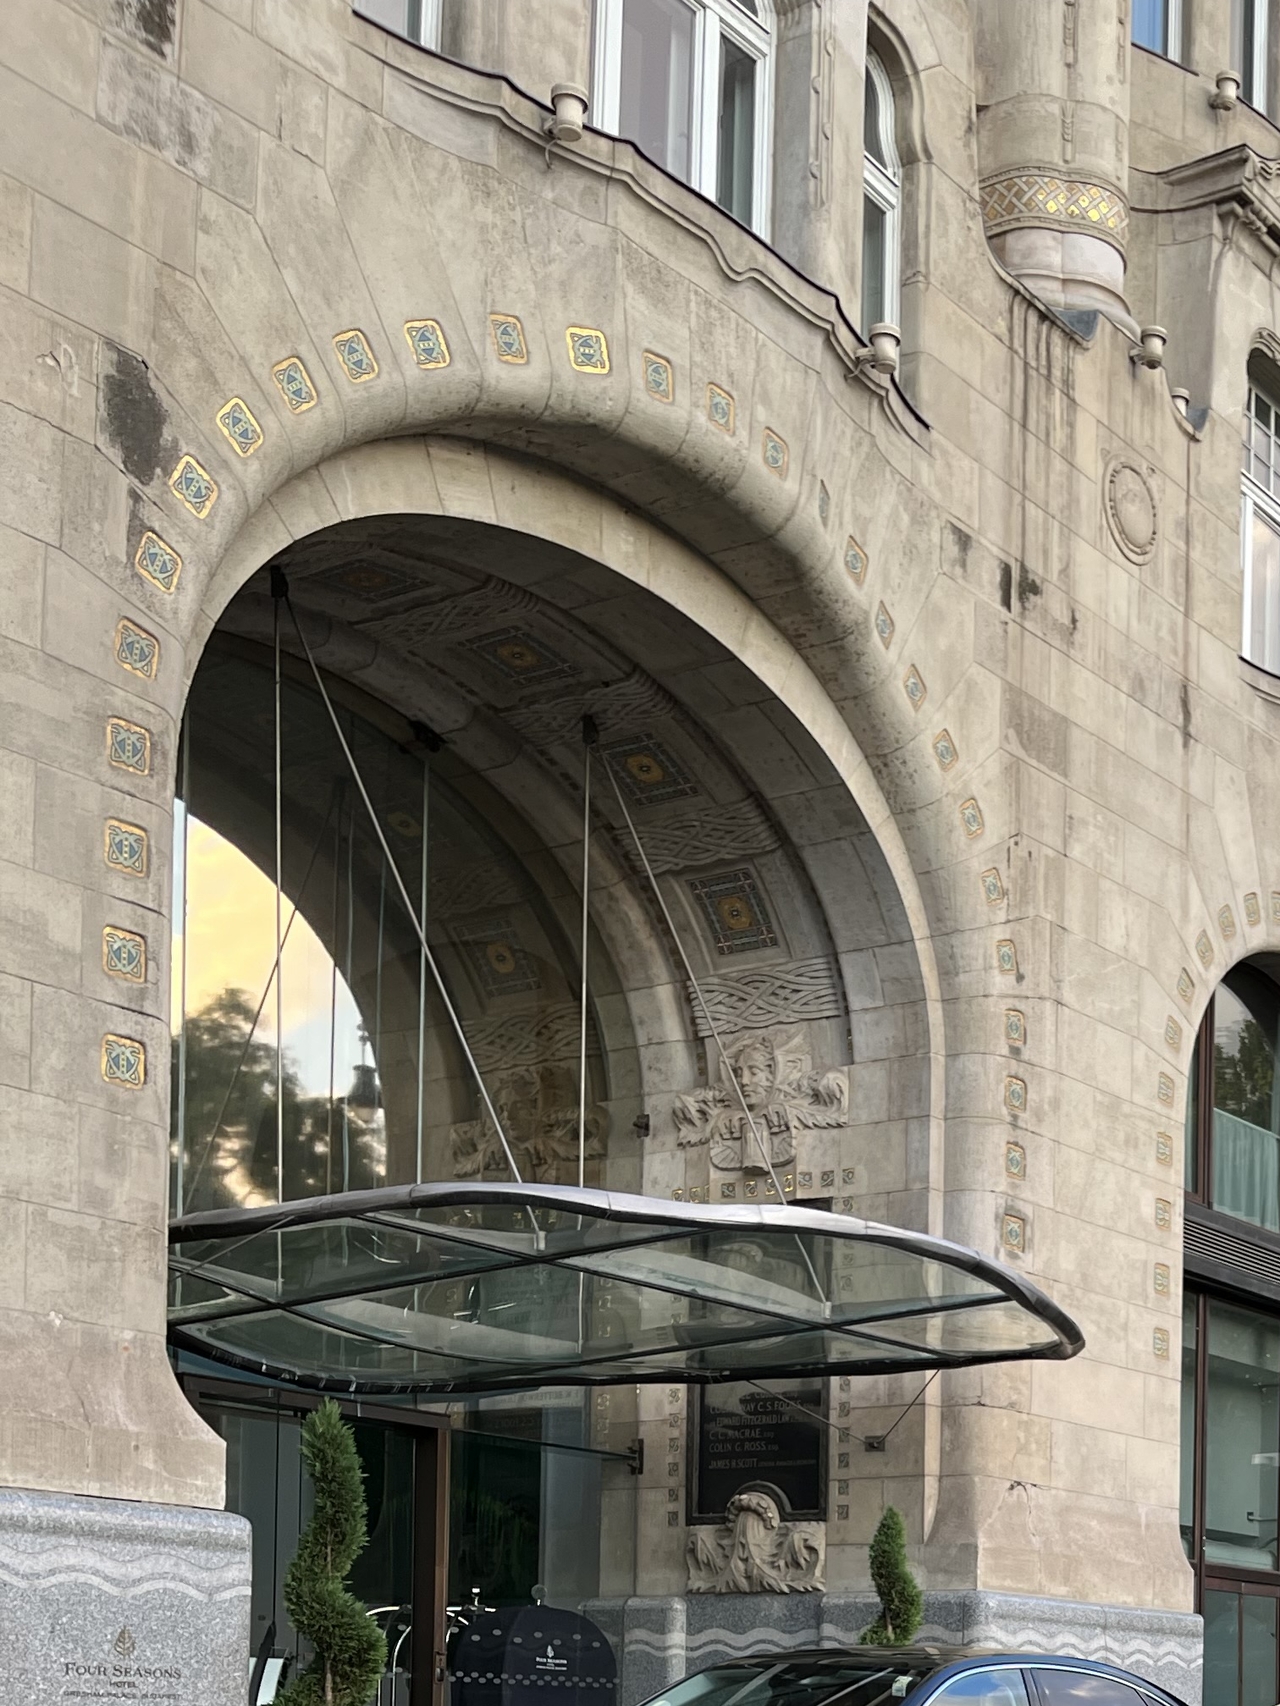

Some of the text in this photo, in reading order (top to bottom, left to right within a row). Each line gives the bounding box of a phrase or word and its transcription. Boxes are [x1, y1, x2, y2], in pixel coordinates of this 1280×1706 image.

[744, 1441, 767, 1452] ROSS
[63, 1661, 181, 1680] FOUR SEASONS
[109, 1680, 138, 1689] HOTEL
